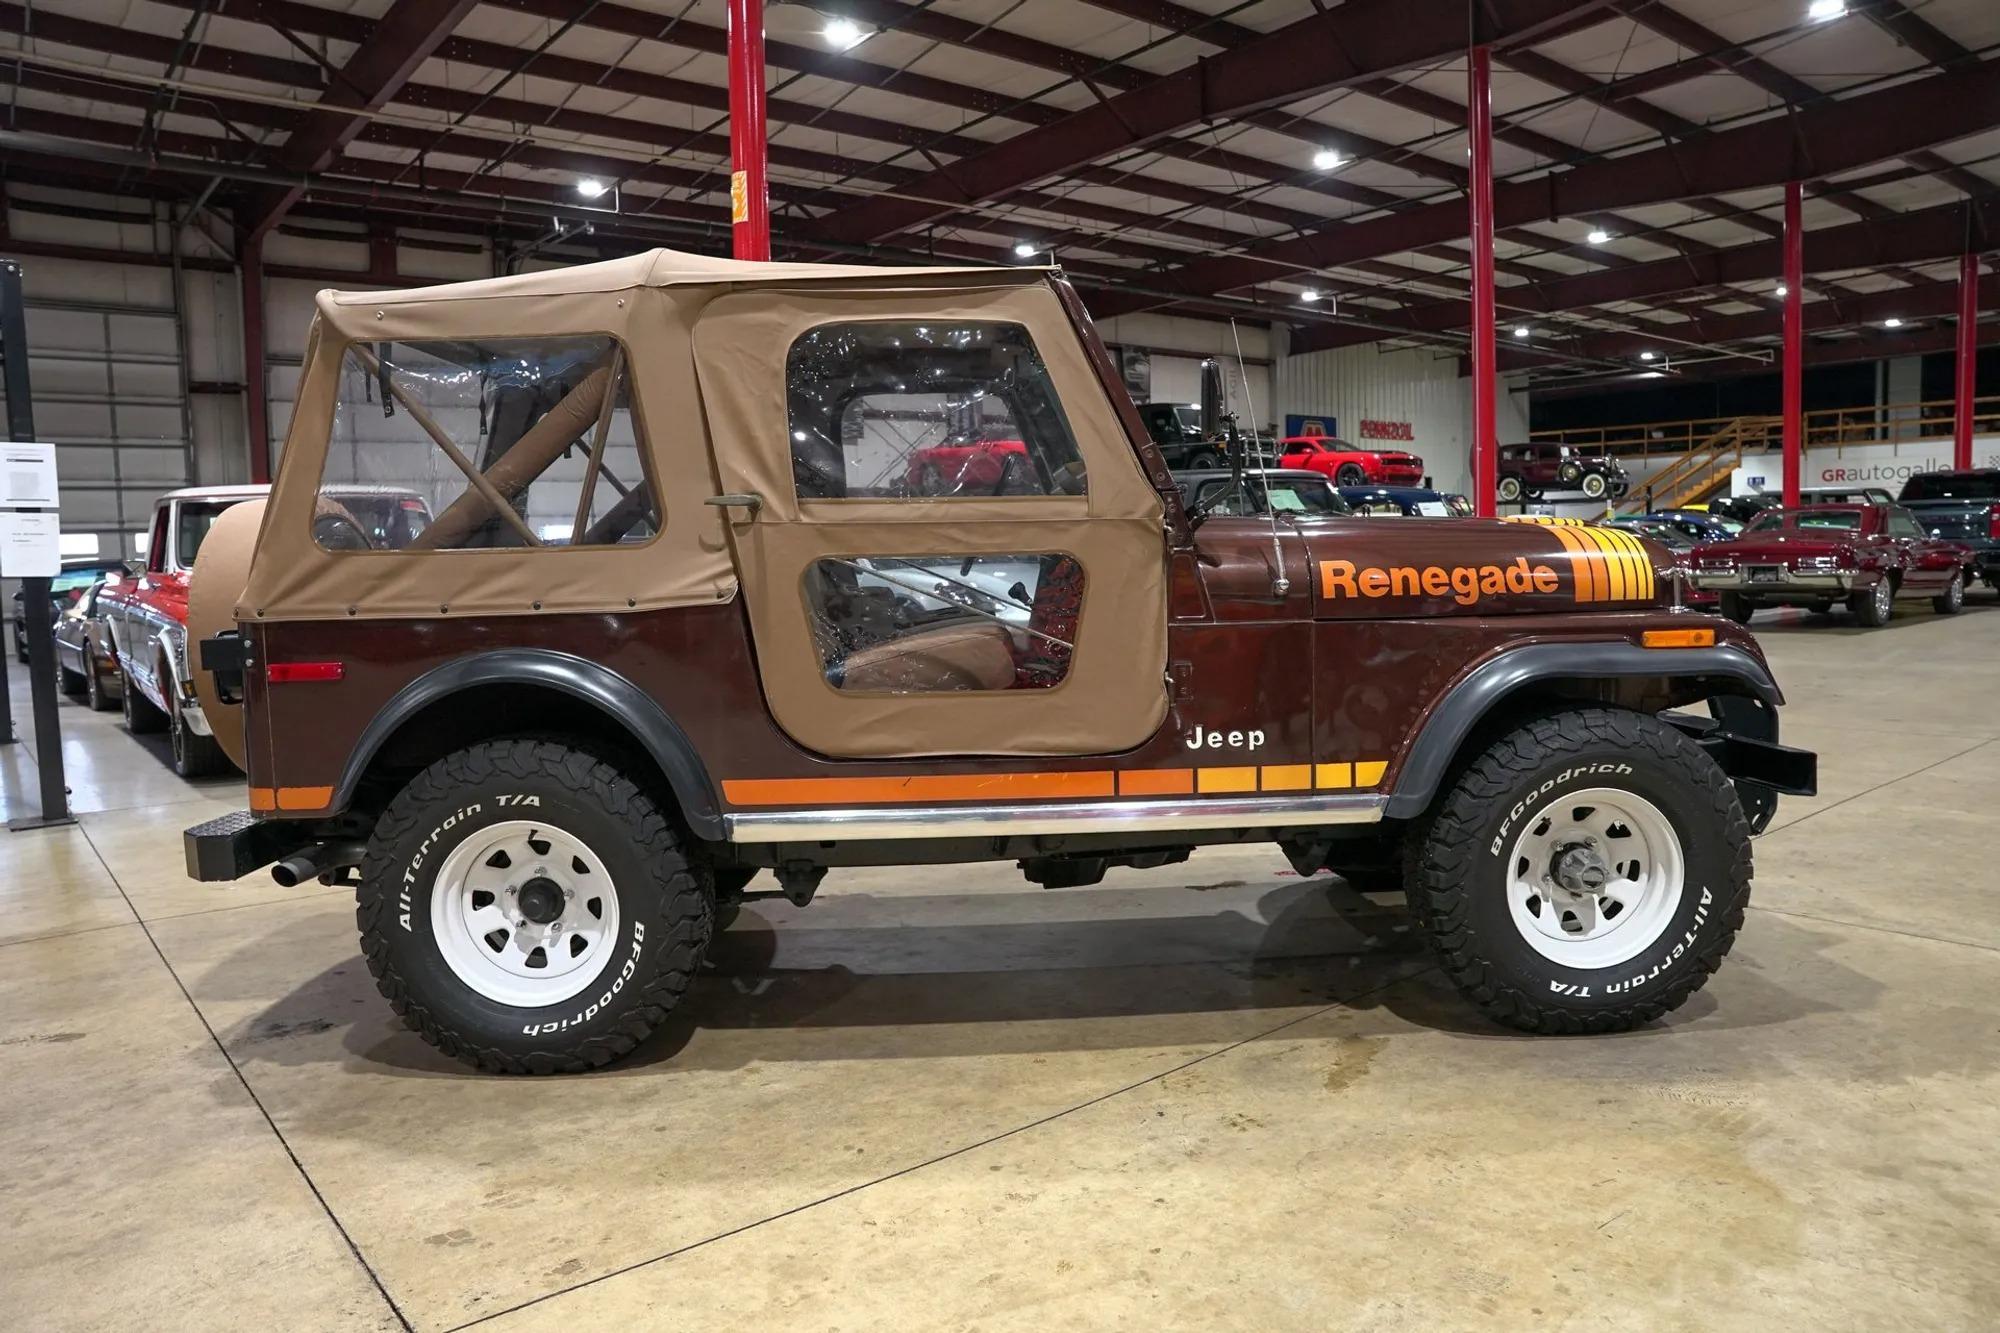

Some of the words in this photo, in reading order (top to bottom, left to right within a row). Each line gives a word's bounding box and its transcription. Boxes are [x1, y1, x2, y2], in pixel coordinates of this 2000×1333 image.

[1319, 557, 1559, 606] Renegade
[1185, 726, 1265, 751] Jeep
[1490, 762, 1634, 857] BFGoodrich
[399, 802, 482, 932] All-Terrain
[495, 794, 541, 807] T/A
[522, 919, 646, 1037] BFGoodrich
[1605, 885, 1714, 995] All-Terrain
[1549, 979, 1592, 998] T/A
